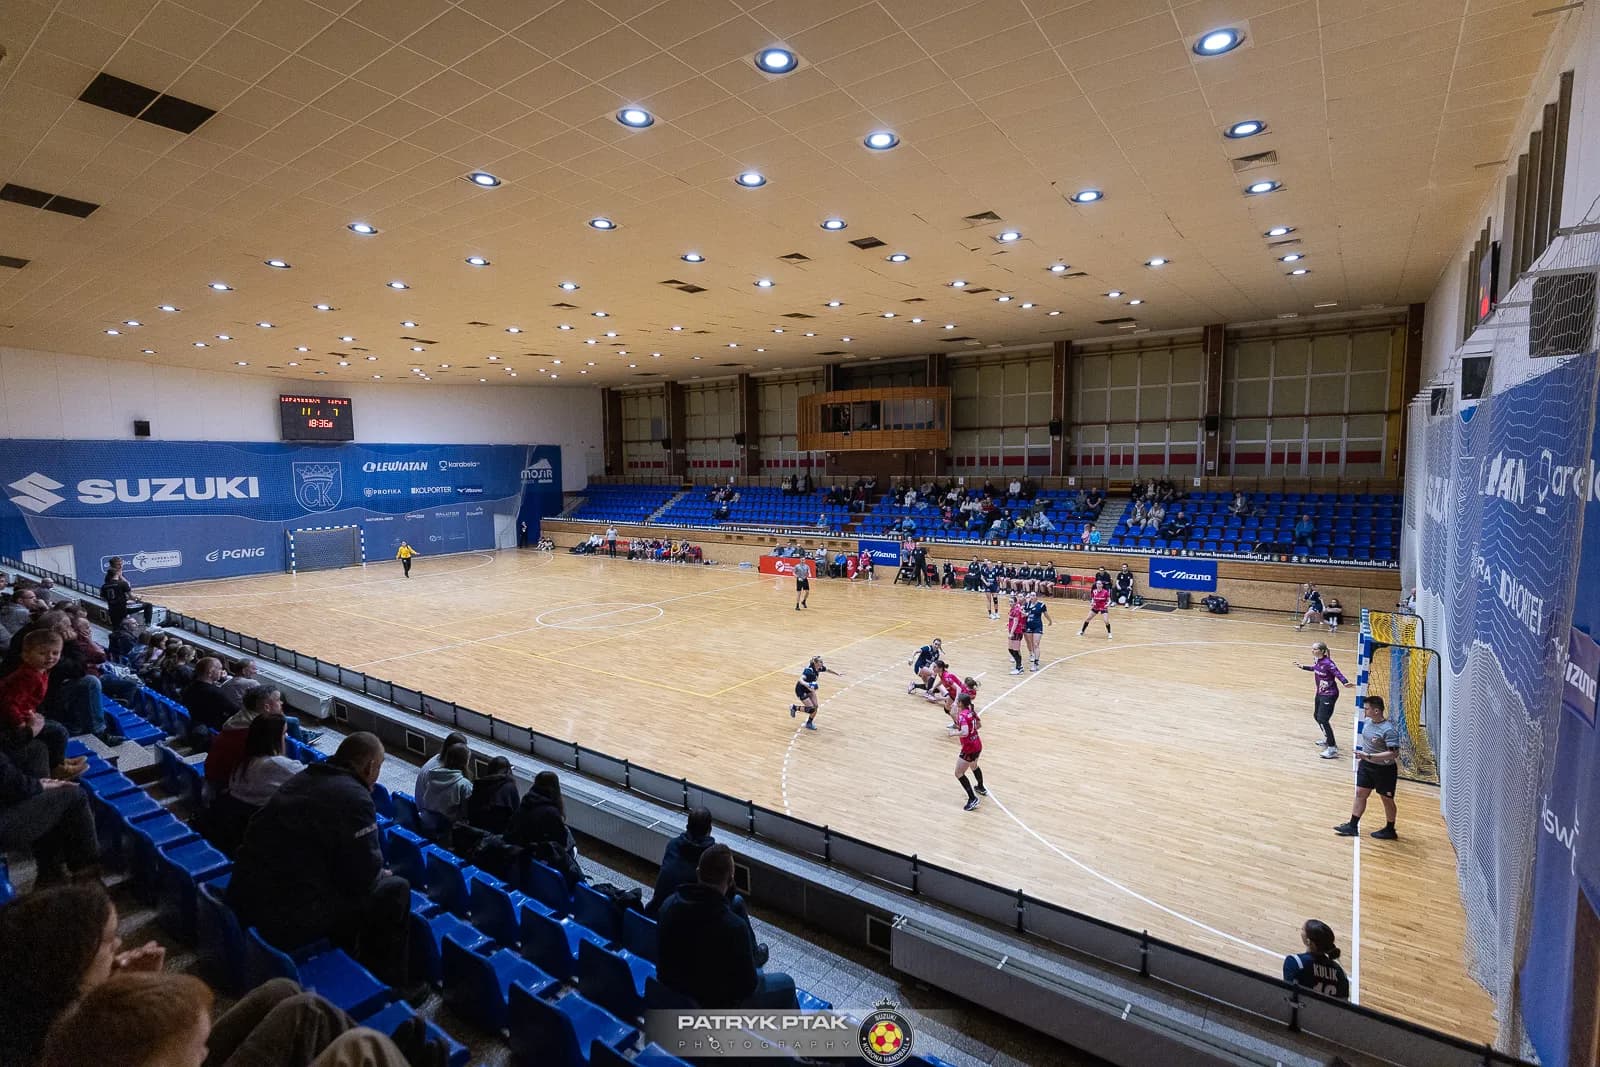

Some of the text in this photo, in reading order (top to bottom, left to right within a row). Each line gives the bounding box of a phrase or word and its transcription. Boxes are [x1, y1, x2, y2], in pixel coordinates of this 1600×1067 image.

[376, 461, 428, 472] LEWIATAN
[77, 477, 259, 504] SUZUKI
[1309, 557, 1399, 569] www.koronahandball.pl
[1313, 963, 1338, 981] KULIK
